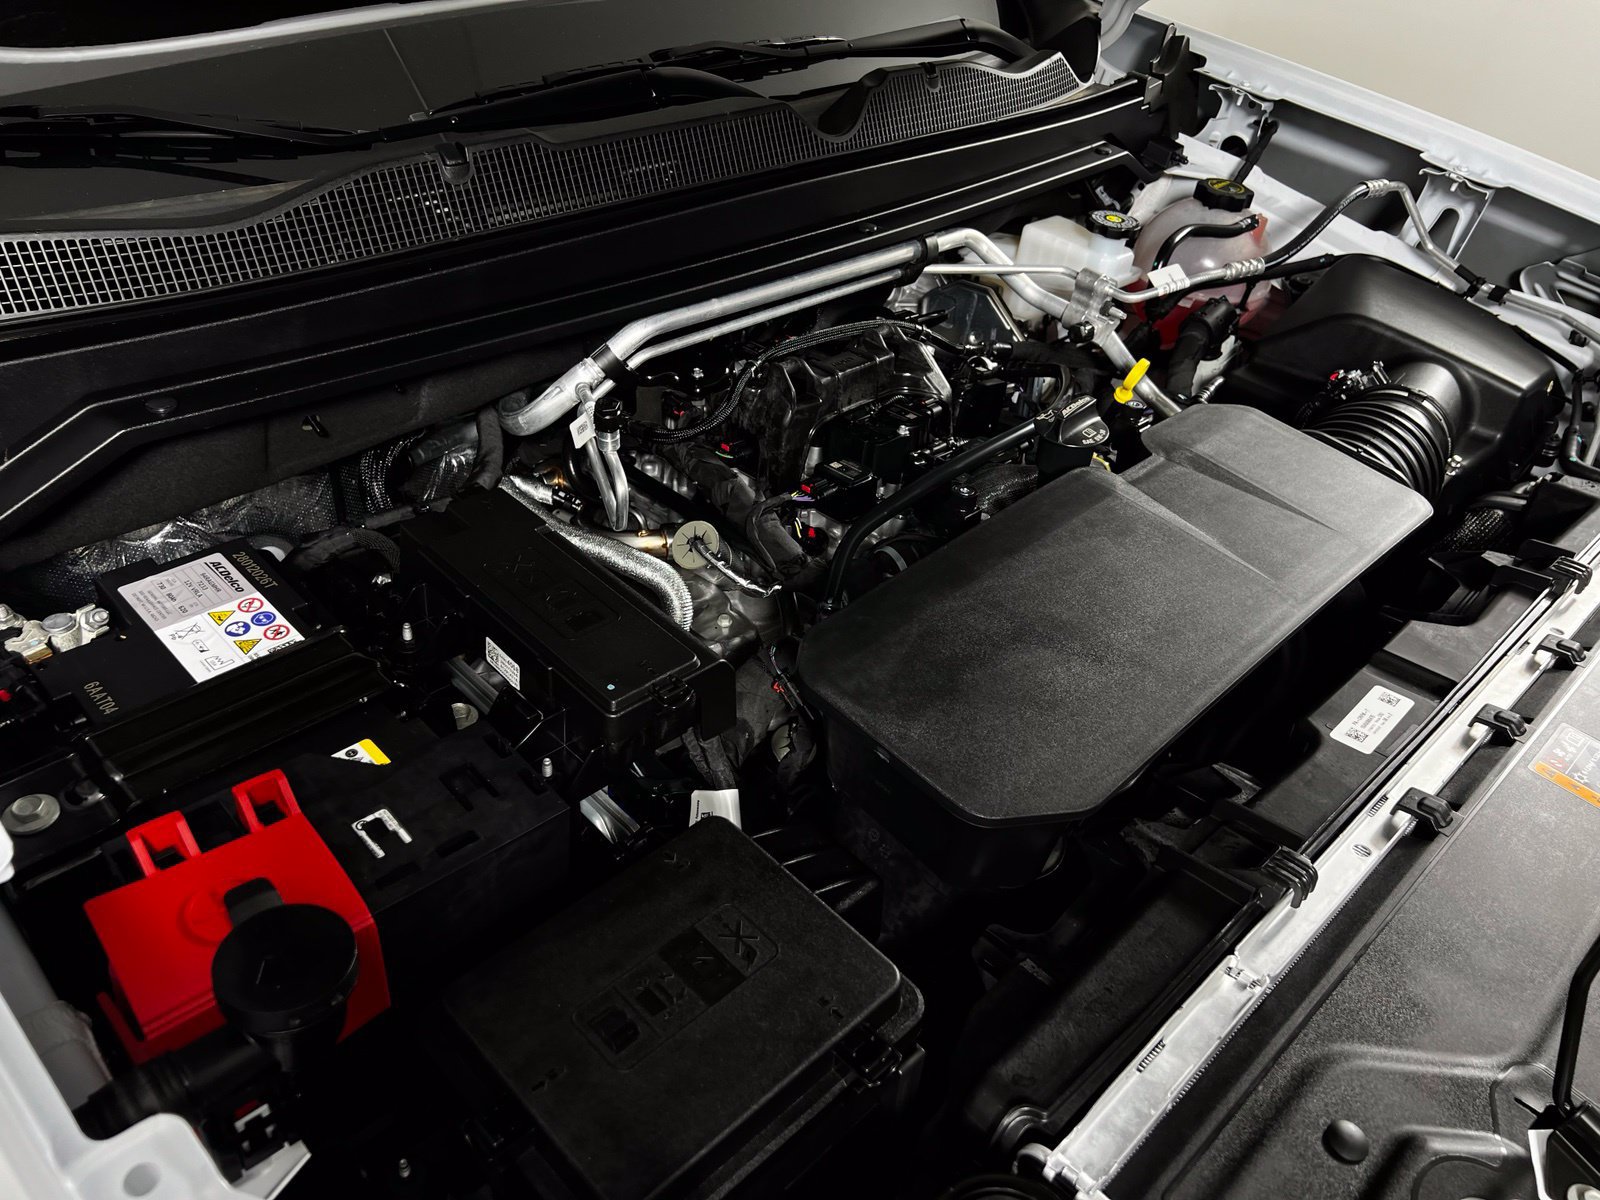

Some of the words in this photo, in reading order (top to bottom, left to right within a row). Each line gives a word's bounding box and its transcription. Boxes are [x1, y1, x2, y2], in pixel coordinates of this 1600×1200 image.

[209, 561, 245, 593] ACDelco
[232, 551, 278, 589] 28012026T
[83, 681, 119, 715] 6AAT04
